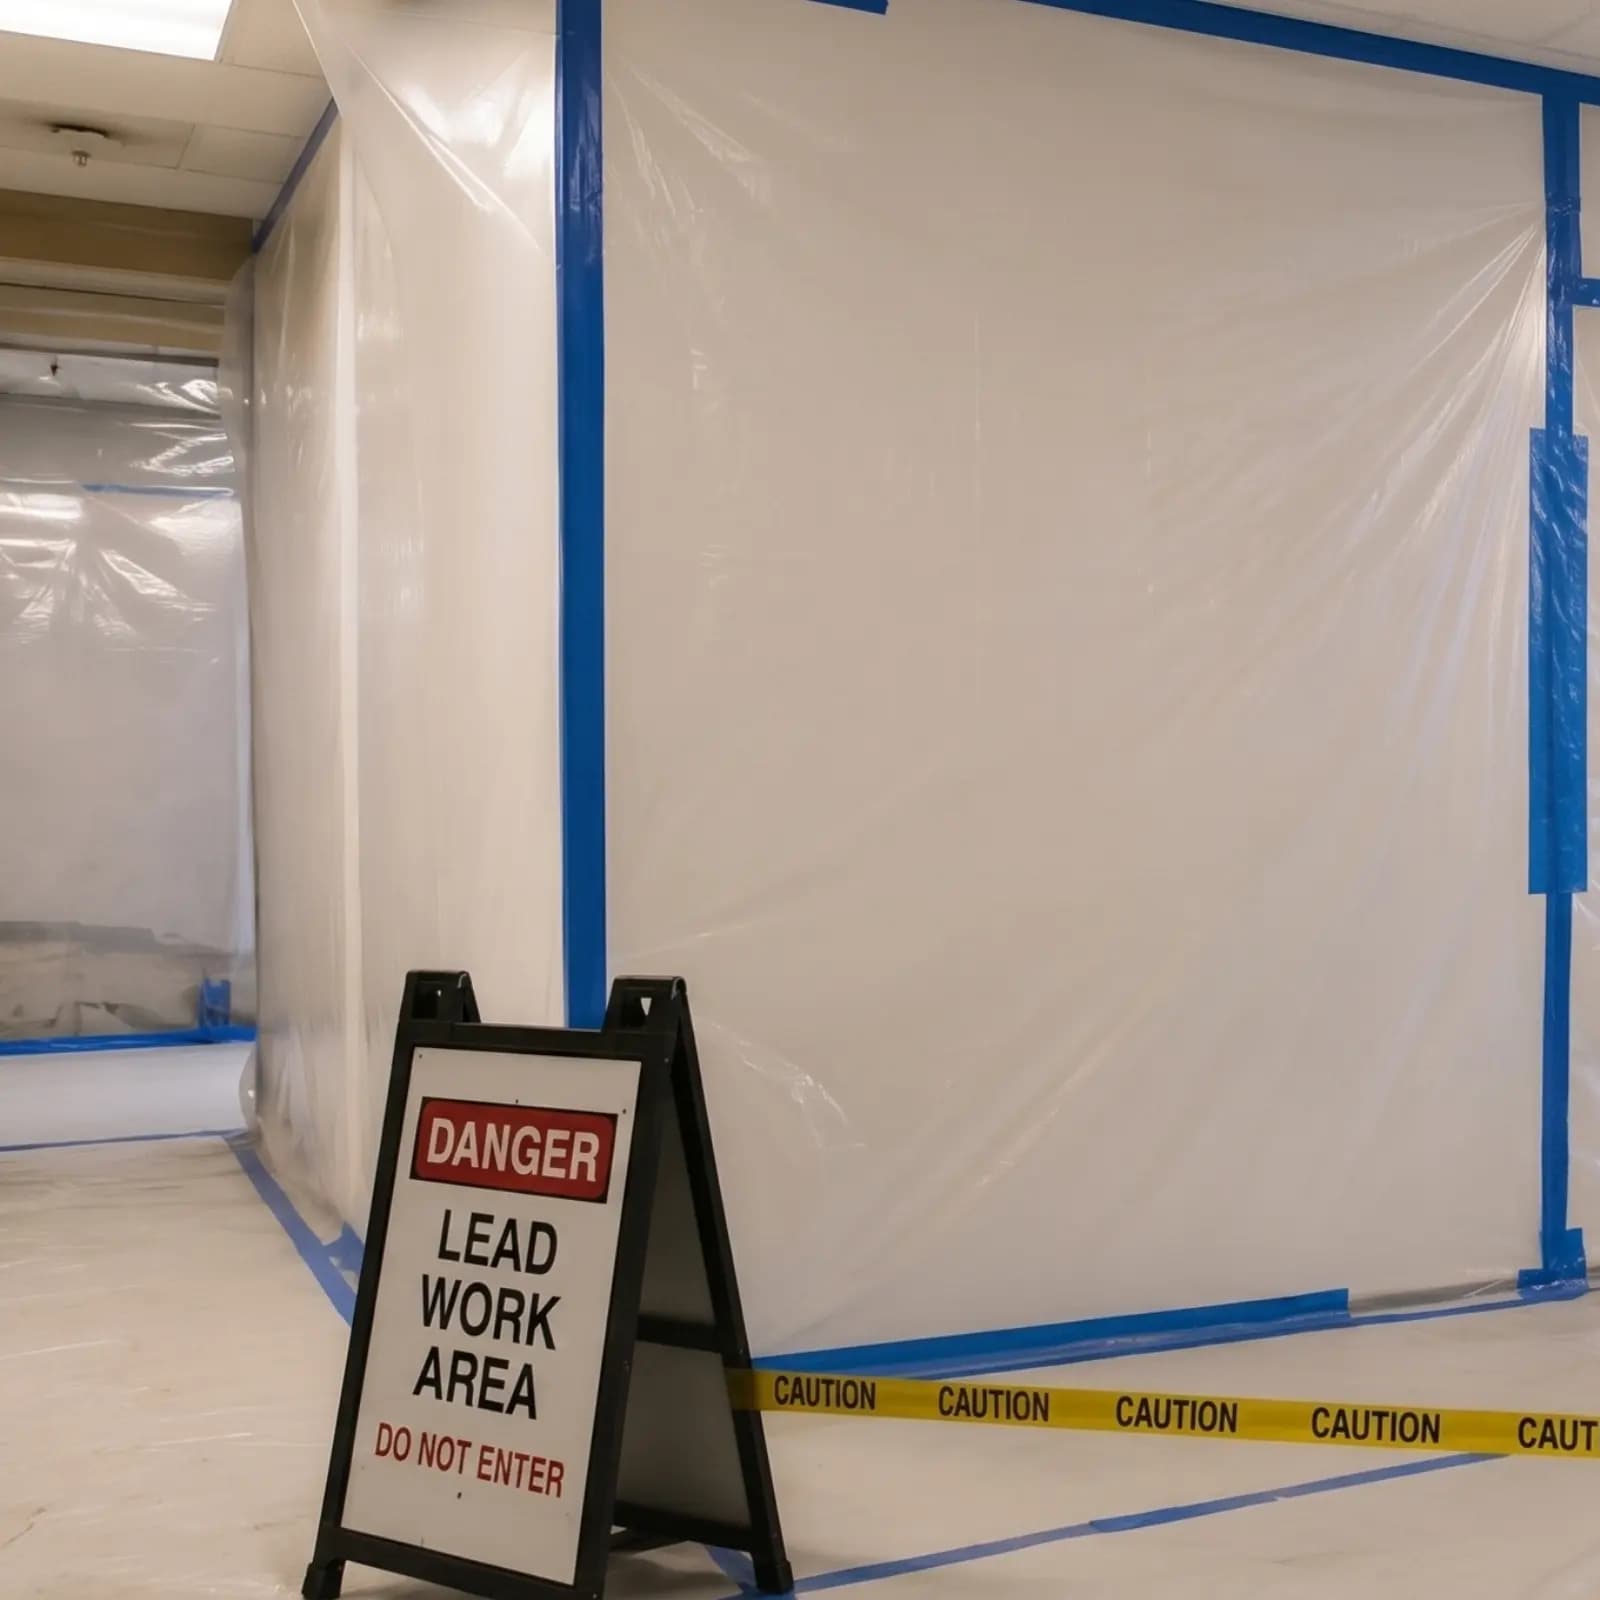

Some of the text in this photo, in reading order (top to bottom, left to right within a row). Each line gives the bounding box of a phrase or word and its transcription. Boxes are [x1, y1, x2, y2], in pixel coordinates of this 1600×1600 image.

[426, 1118, 600, 1182] DANGER
[437, 1209, 558, 1275] LEAD
[421, 1273, 561, 1351] WORK
[413, 1346, 537, 1420] AREA
[773, 1375, 876, 1410] CAUTION
[938, 1386, 1050, 1422] CAUTION
[1116, 1396, 1238, 1433] CAUTION
[1311, 1407, 1441, 1443] CAUTION
[375, 1423, 565, 1498] DO NOT ENTER
